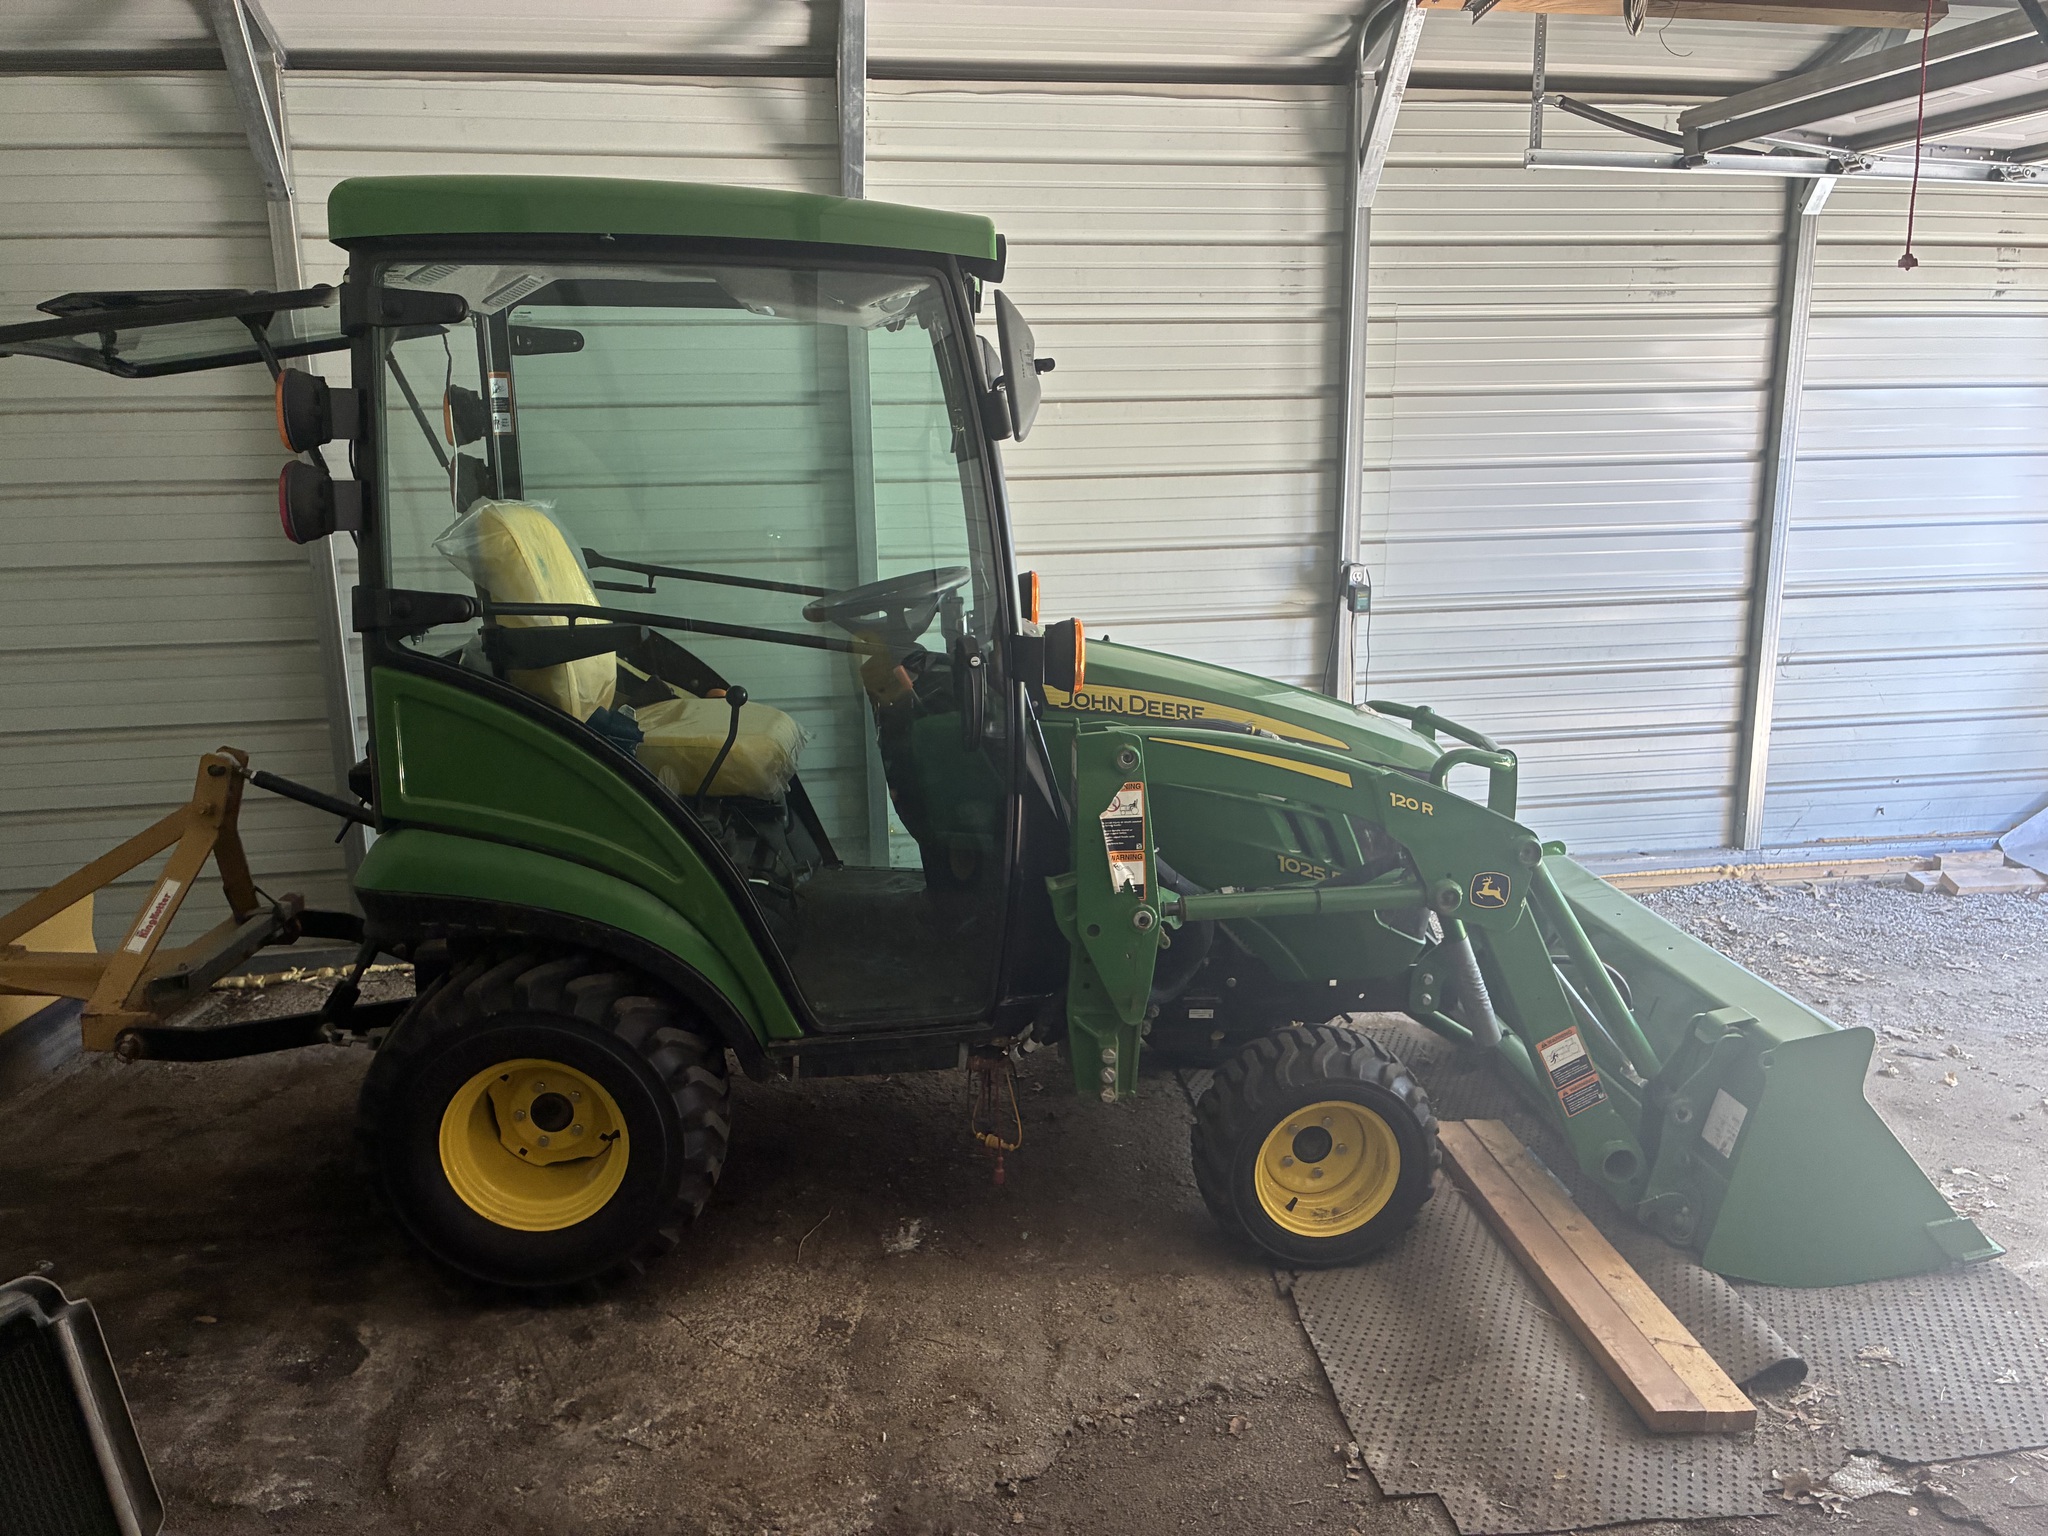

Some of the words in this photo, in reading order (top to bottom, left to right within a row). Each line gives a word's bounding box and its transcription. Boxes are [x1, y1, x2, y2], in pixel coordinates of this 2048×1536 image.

[1060, 692, 1123, 712] JOHN
[1129, 694, 1205, 719] DEERE
[1389, 791, 1419, 811] 120
[1421, 801, 1434, 816] R
[1277, 854, 1326, 880] 1025
